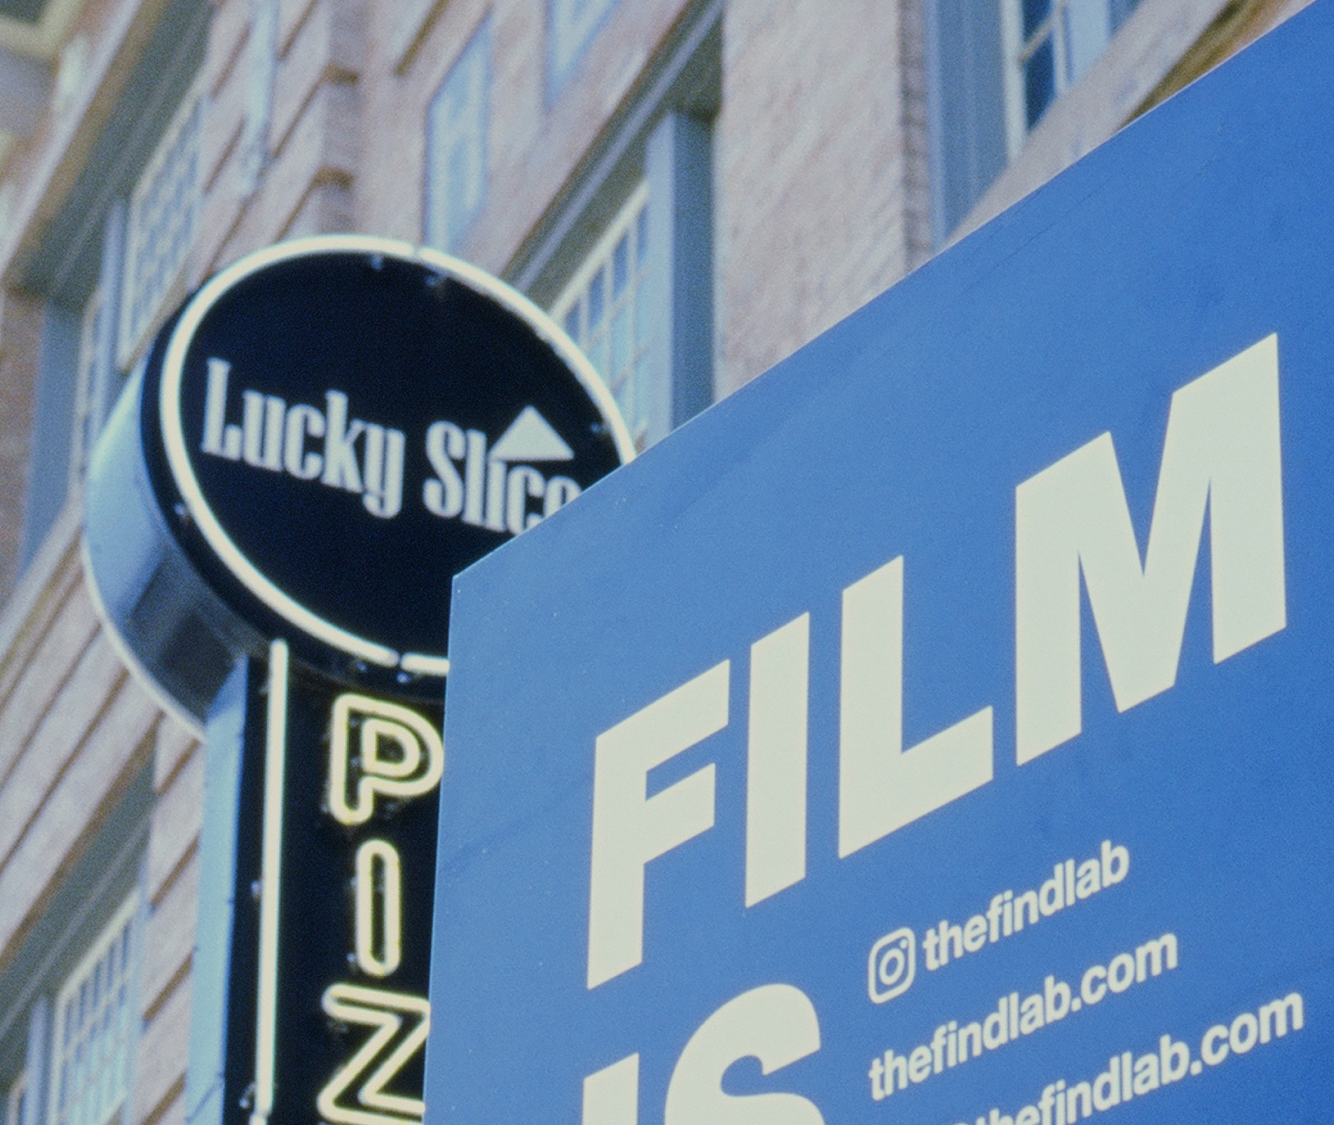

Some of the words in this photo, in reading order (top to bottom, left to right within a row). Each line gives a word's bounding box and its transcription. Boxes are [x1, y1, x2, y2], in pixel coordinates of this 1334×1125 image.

[201, 357, 406, 520] Lucky
[585, 332, 1288, 991] FILM
[922, 840, 1131, 972] thefindlab
[867, 932, 1181, 1102] thefindlab.com
